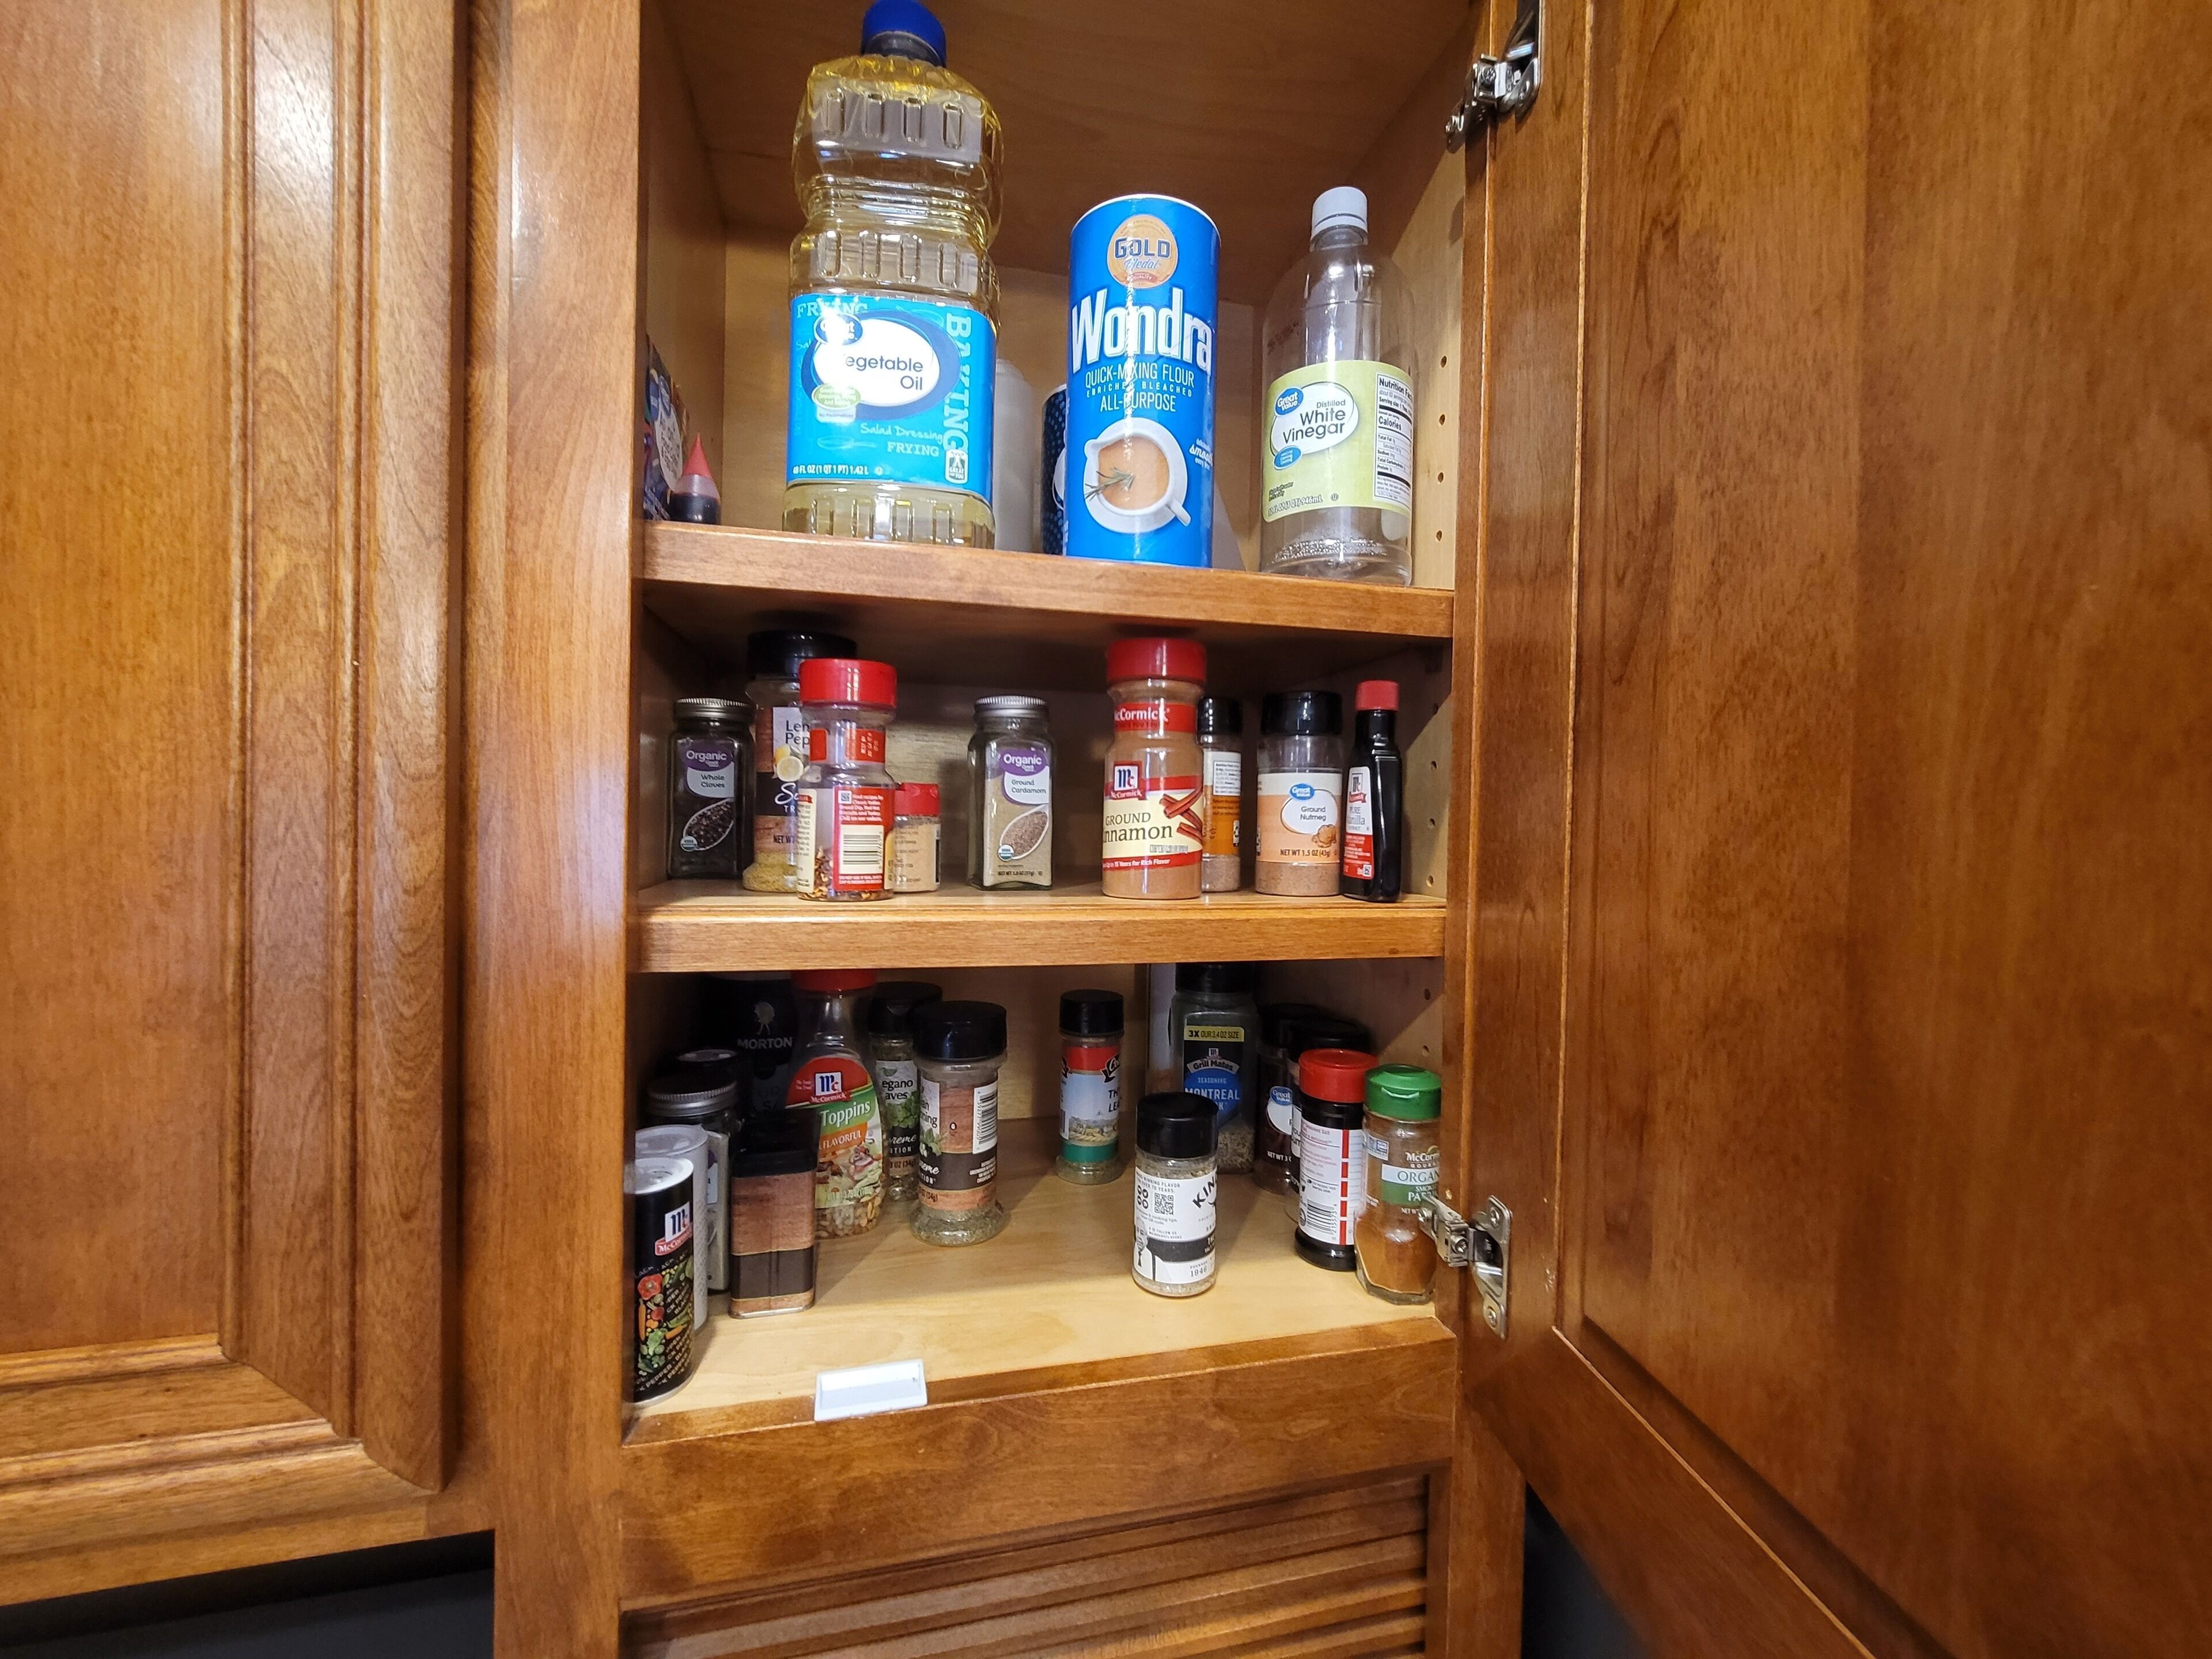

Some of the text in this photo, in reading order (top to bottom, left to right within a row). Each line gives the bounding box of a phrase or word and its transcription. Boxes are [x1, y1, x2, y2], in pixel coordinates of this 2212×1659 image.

[1115, 237, 1170, 258] GOLD
[1124, 257, 1159, 271] Medal
[1072, 287, 1213, 376] Wondra
[844, 355, 923, 373] egetable
[900, 375, 923, 391] Oil
[1162, 363, 1195, 388] FLOUR
[1142, 381, 1192, 397] BLEACHED
[1379, 377, 1404, 395] Nutrition
[1100, 392, 1177, 412] ALL-PURPOSE
[1278, 392, 1299, 408] Great
[1317, 399, 1346, 408] Distilled
[1379, 396, 1392, 405] Serving
[1300, 408, 1346, 426] White
[1378, 416, 1402, 430] Calories
[860, 423, 943, 444] Salad Dressing
[1283, 422, 1345, 444] Vinegar
[887, 441, 940, 457] FRYING
[807, 464, 816, 474] OZ
[1301, 494, 1323, 505] 946mL
[1115, 707, 1169, 722] cCormick
[686, 750, 727, 763] Organic
[1003, 753, 1042, 767] Organic
[1291, 786, 1310, 794] Great
[1105, 812, 1151, 825] GROUND
[1300, 813, 1326, 821] Nutmeg
[737, 1036, 793, 1050] MORTON
[1193, 1060, 1233, 1071] Grill Mates
[819, 1074, 839, 1092] Mc
[810, 1092, 847, 1103] McCormick
[1185, 1088, 1240, 1100] MONTREAL
[1272, 1089, 1291, 1099] Great
[820, 1101, 870, 1128] Toppins
[823, 1130, 862, 1149] FLAVORFUL
[1275, 1153, 1283, 1161] WT
[645, 1363, 672, 1388] PEPPER
